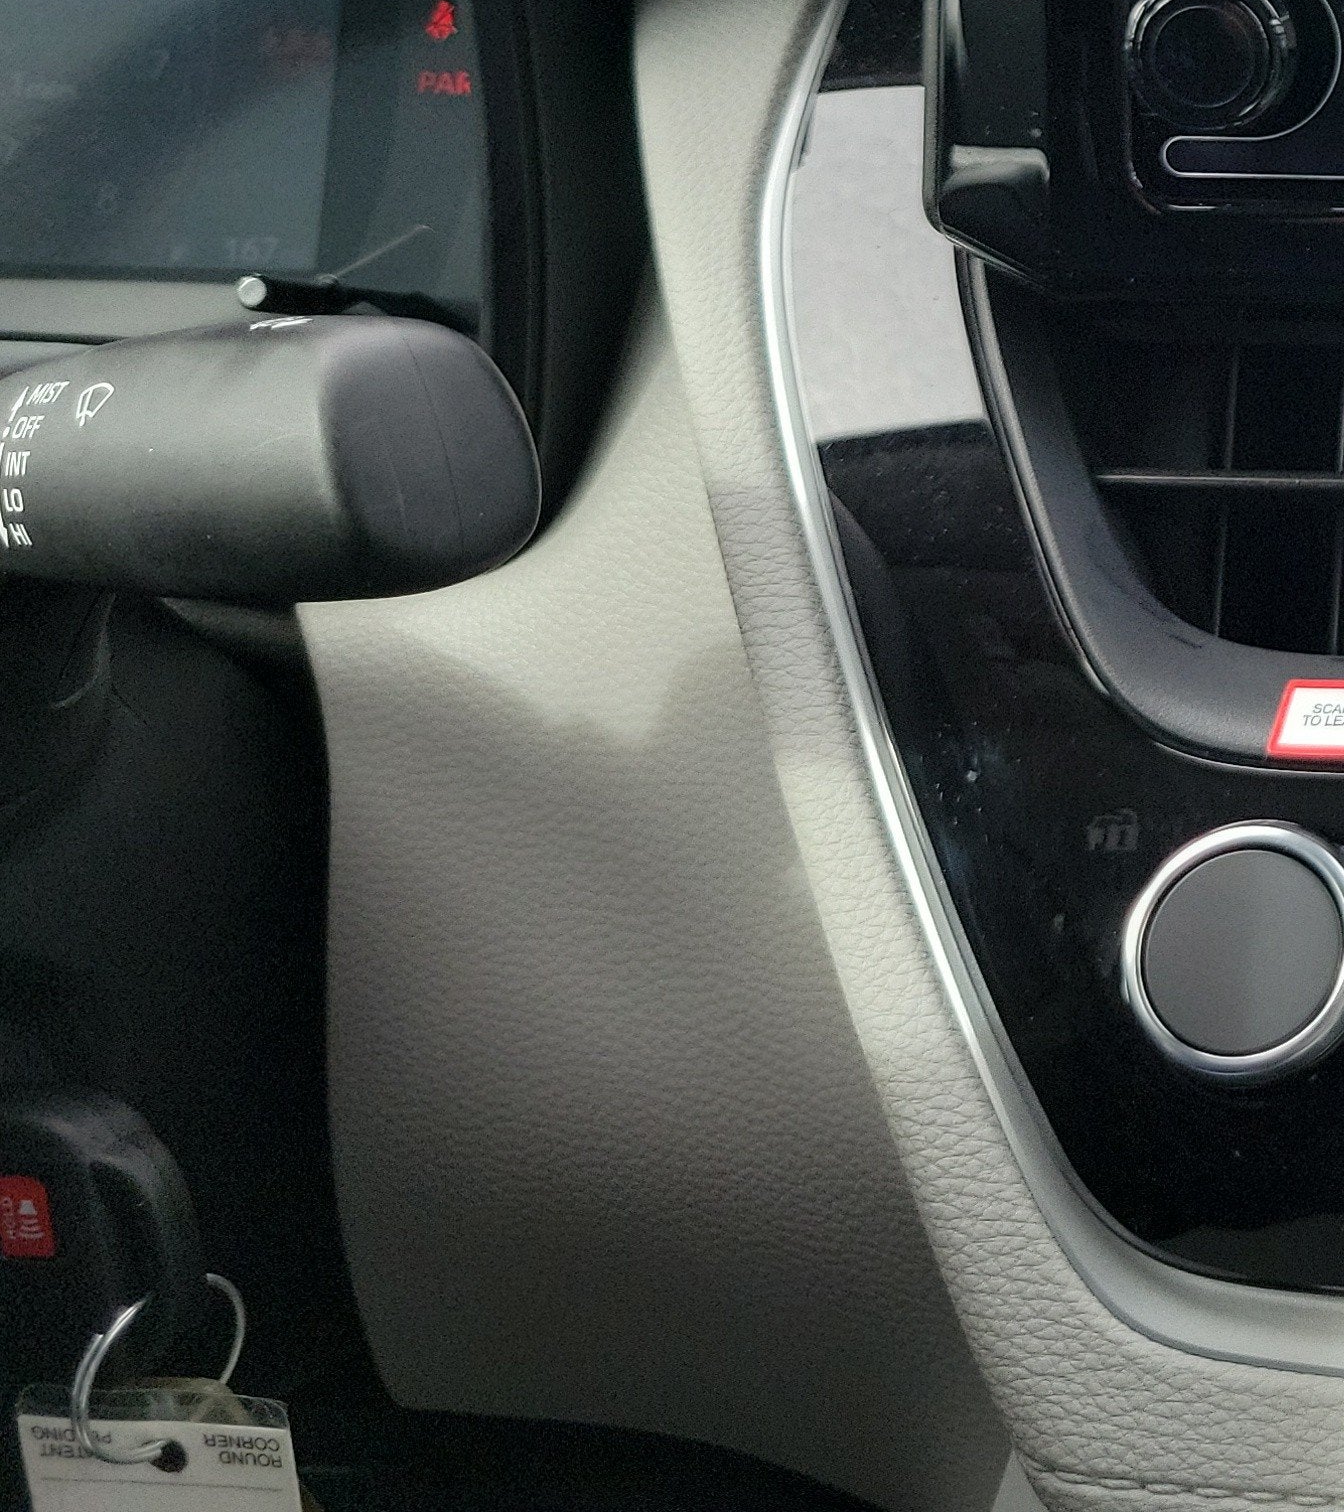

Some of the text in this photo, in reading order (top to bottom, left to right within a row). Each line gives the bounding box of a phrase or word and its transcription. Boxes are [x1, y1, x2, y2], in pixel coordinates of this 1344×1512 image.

[26, 381, 70, 405] MIST
[12, 416, 45, 439] OFF
[5, 451, 31, 477] INT
[4, 488, 24, 512] LO
[9, 523, 33, 546] HI
[1303, 715, 1322, 727] TO
[40, 1443, 92, 1460] ATENT
[203, 1433, 280, 1453] CORNER
[218, 1450, 283, 1469] ROUND
